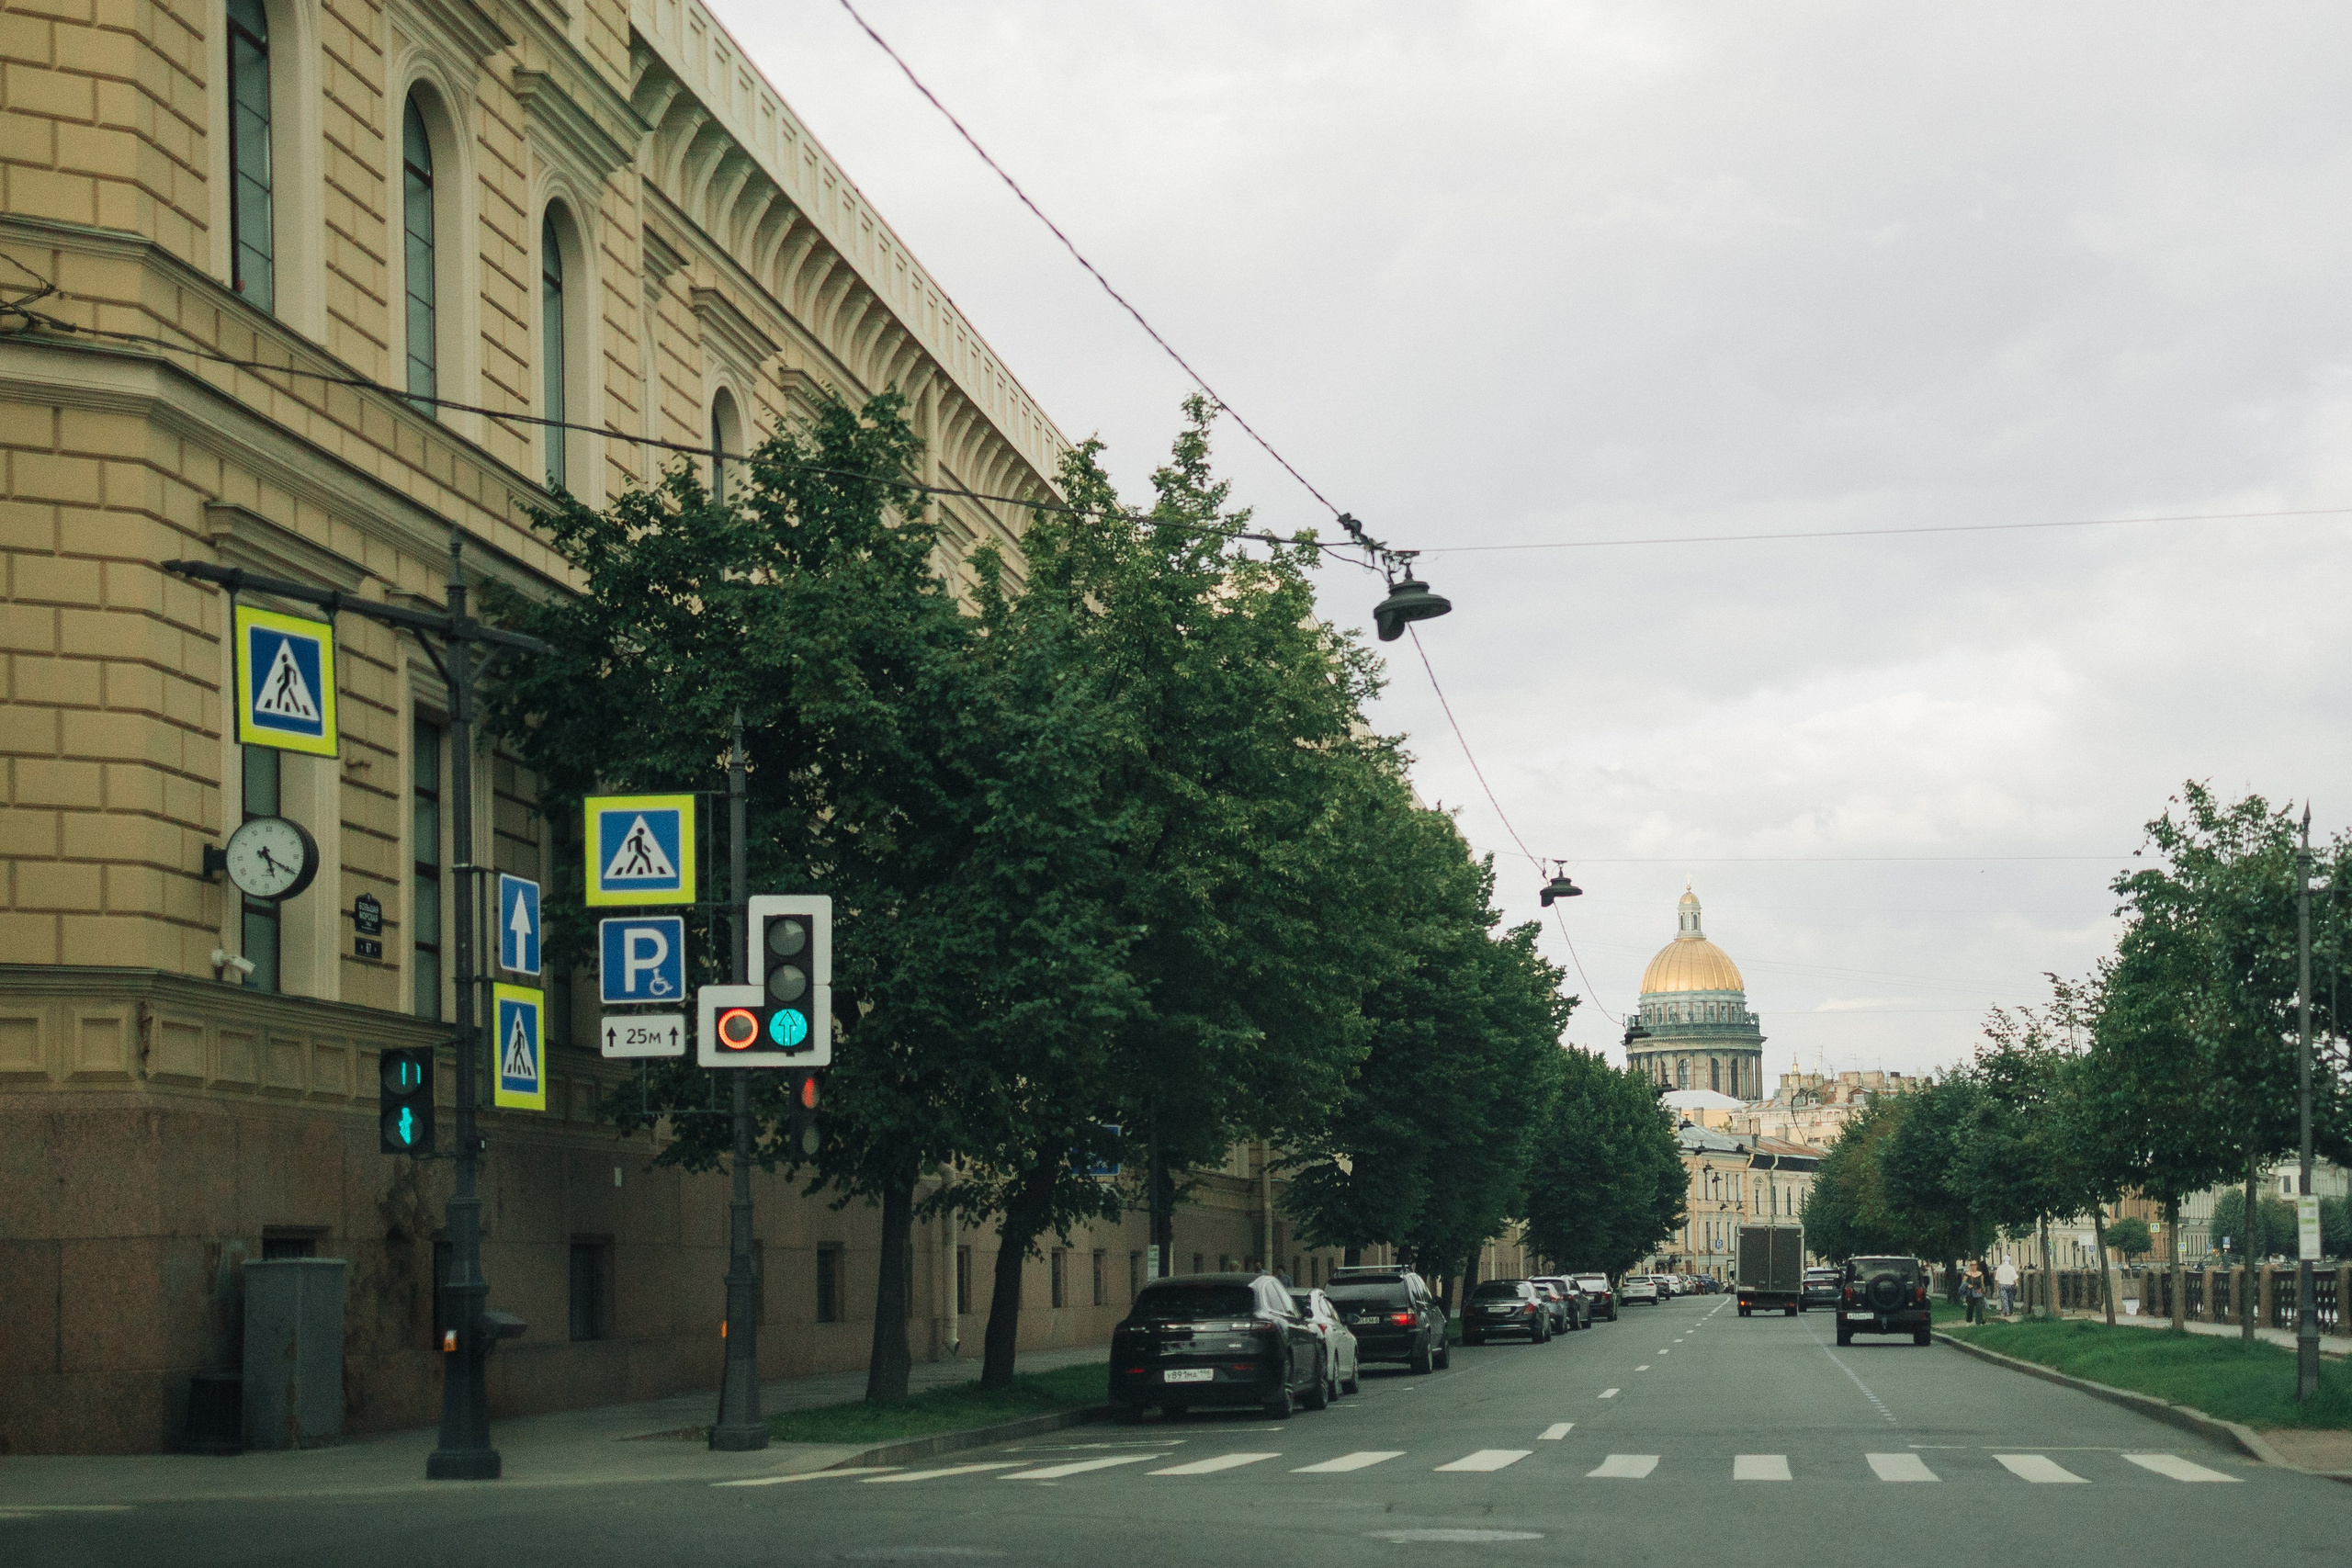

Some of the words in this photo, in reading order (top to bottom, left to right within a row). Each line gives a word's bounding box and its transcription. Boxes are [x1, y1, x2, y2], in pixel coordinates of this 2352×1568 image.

[358, 901, 379, 915] БОЛЬШАЯ
[358, 910, 379, 922] МОРСКАЯ
[624, 928, 669, 993] P
